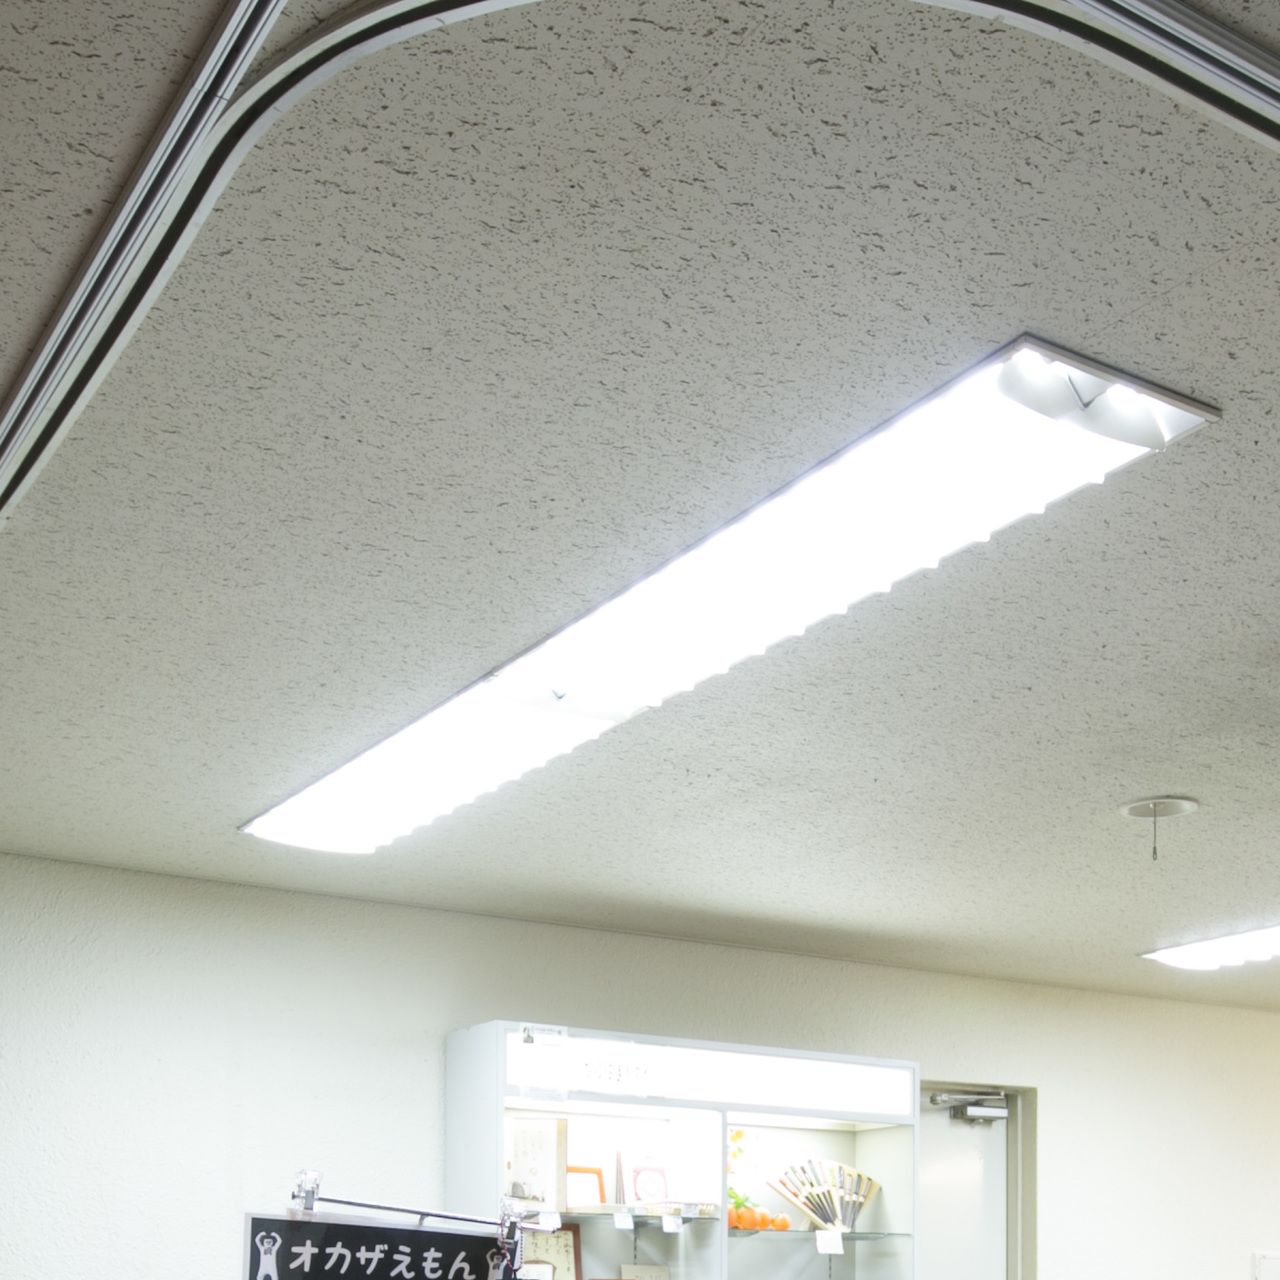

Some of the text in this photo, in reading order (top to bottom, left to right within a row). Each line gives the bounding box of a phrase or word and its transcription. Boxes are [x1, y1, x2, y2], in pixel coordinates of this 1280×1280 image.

[289, 1239, 476, 1280] オカザえもん
